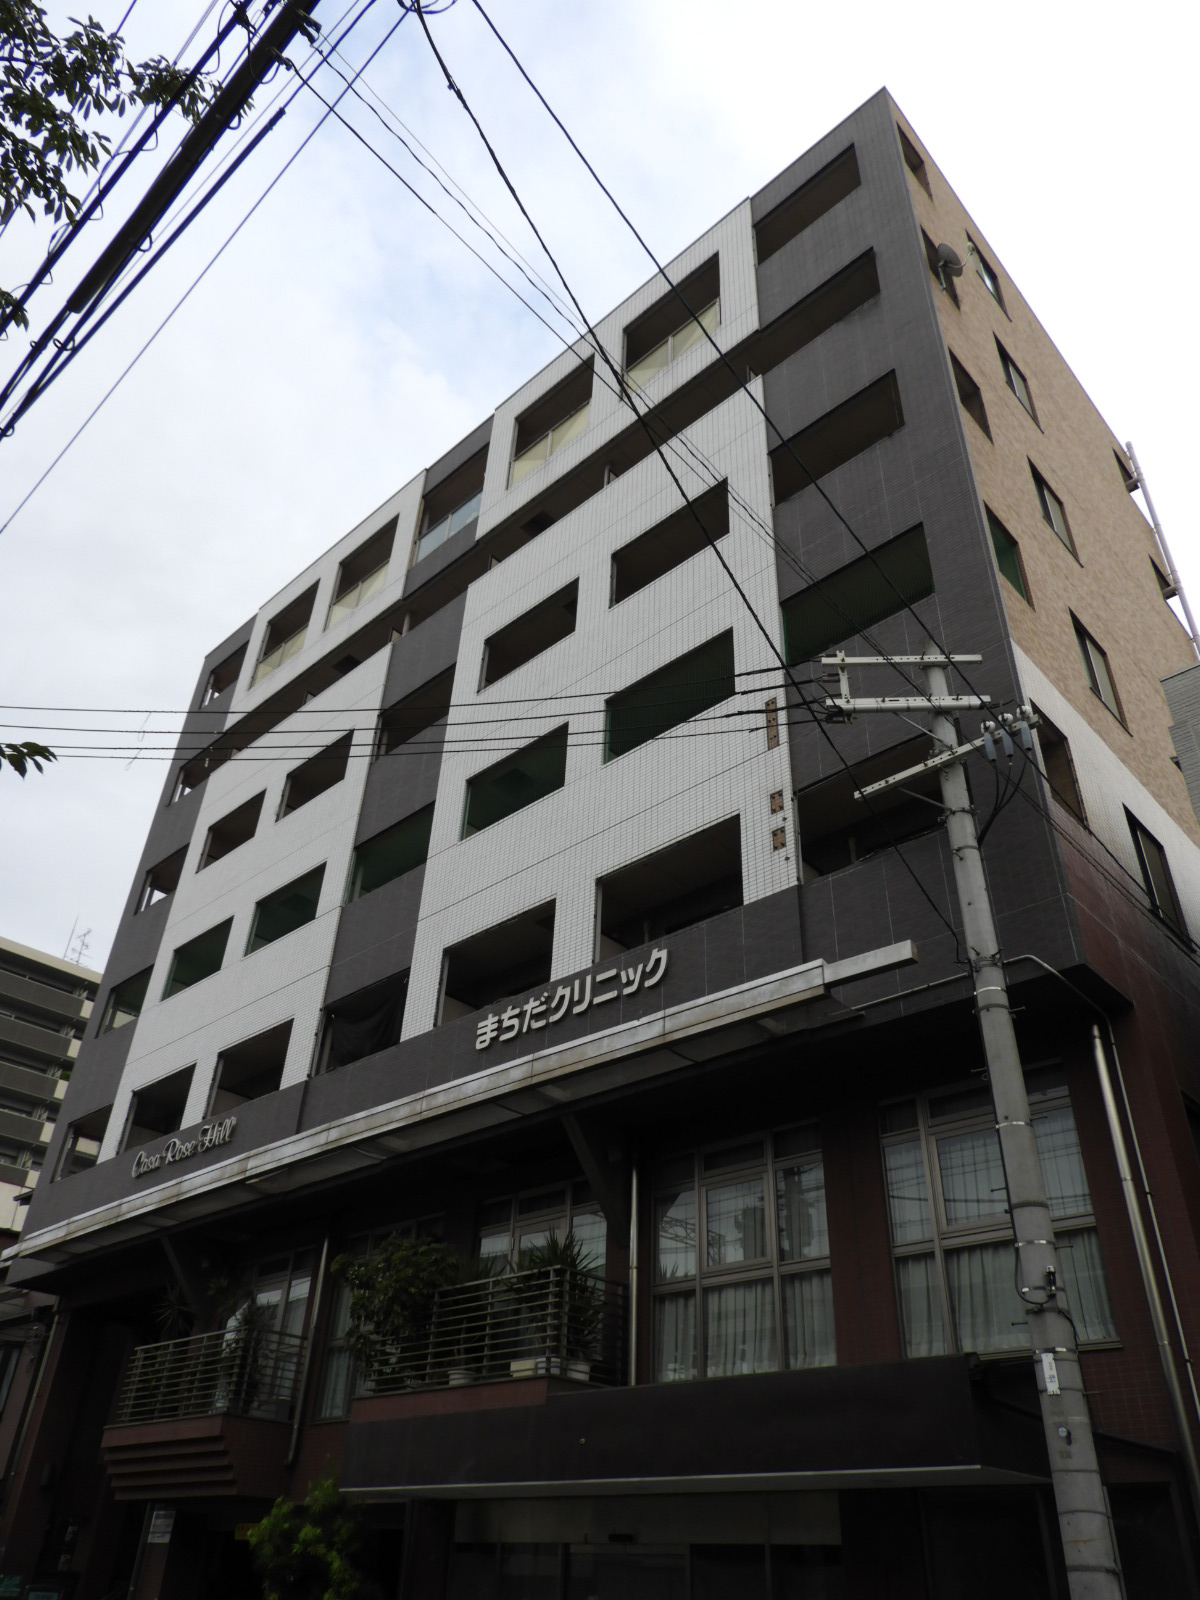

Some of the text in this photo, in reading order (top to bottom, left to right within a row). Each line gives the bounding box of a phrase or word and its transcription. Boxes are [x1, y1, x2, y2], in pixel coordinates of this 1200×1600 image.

[475, 947, 668, 1050] まちだクリニック
[131, 1116, 237, 1178] Casa Rose Hill
